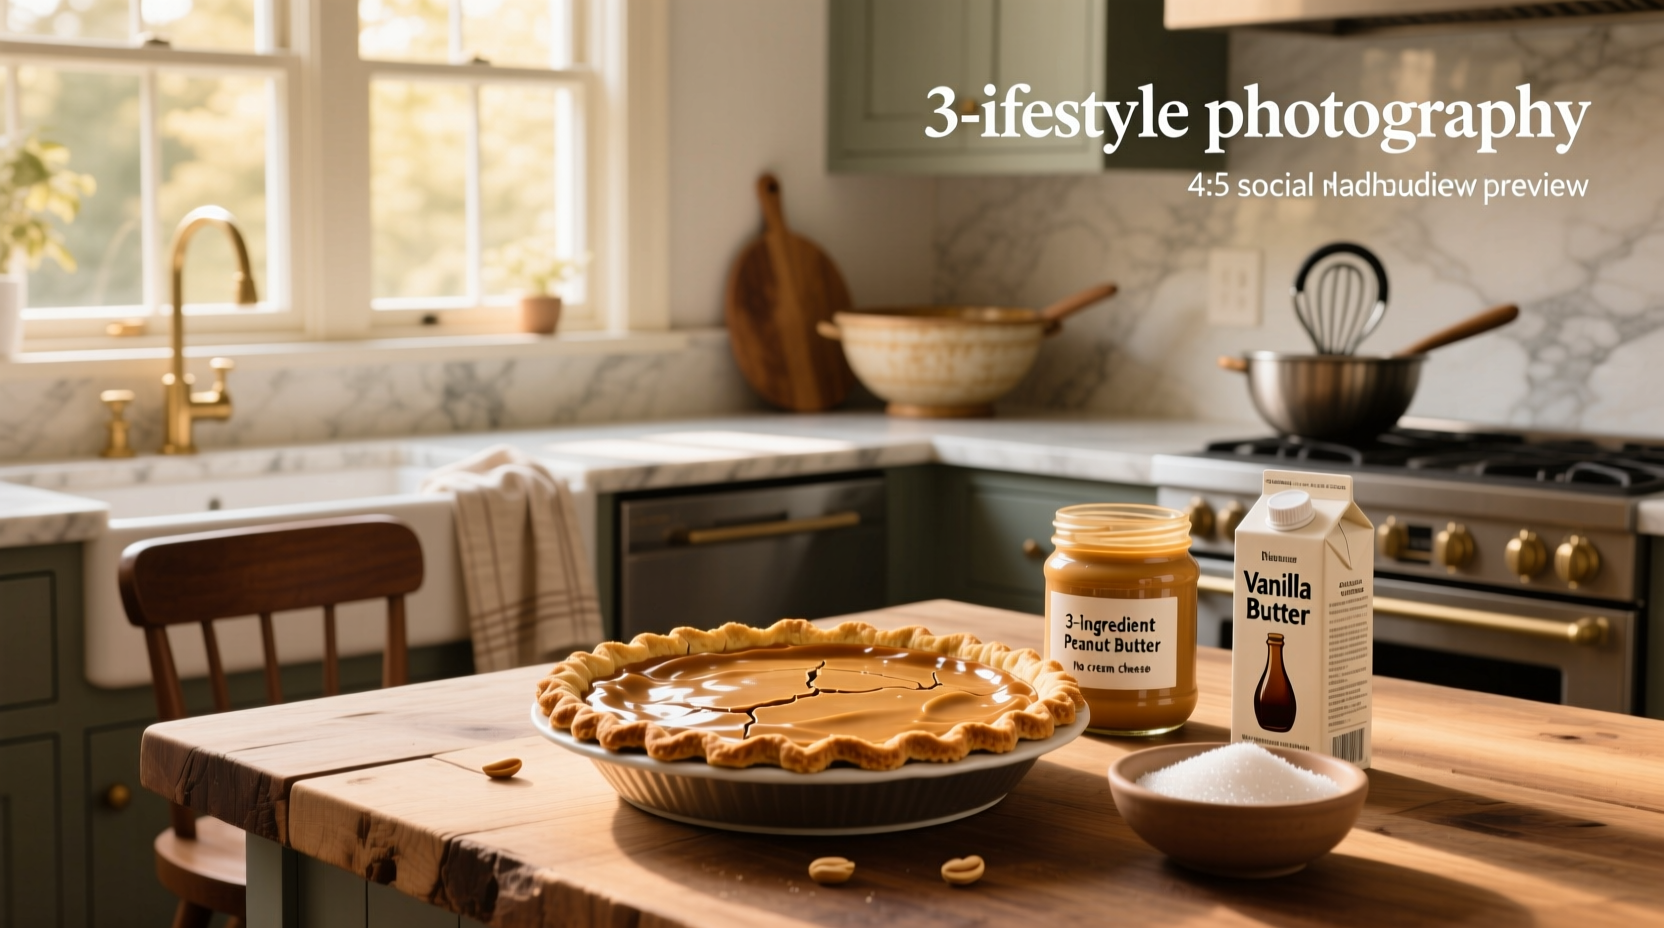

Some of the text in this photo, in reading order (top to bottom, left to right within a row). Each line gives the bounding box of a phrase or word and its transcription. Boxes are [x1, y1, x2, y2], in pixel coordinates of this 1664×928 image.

[1243, 570, 1312, 600] Vanilla
[1065, 613, 1156, 636] 3-Ingredient
[1246, 597, 1311, 626] Butter
[1064, 633, 1161, 653] Peanut Butter
